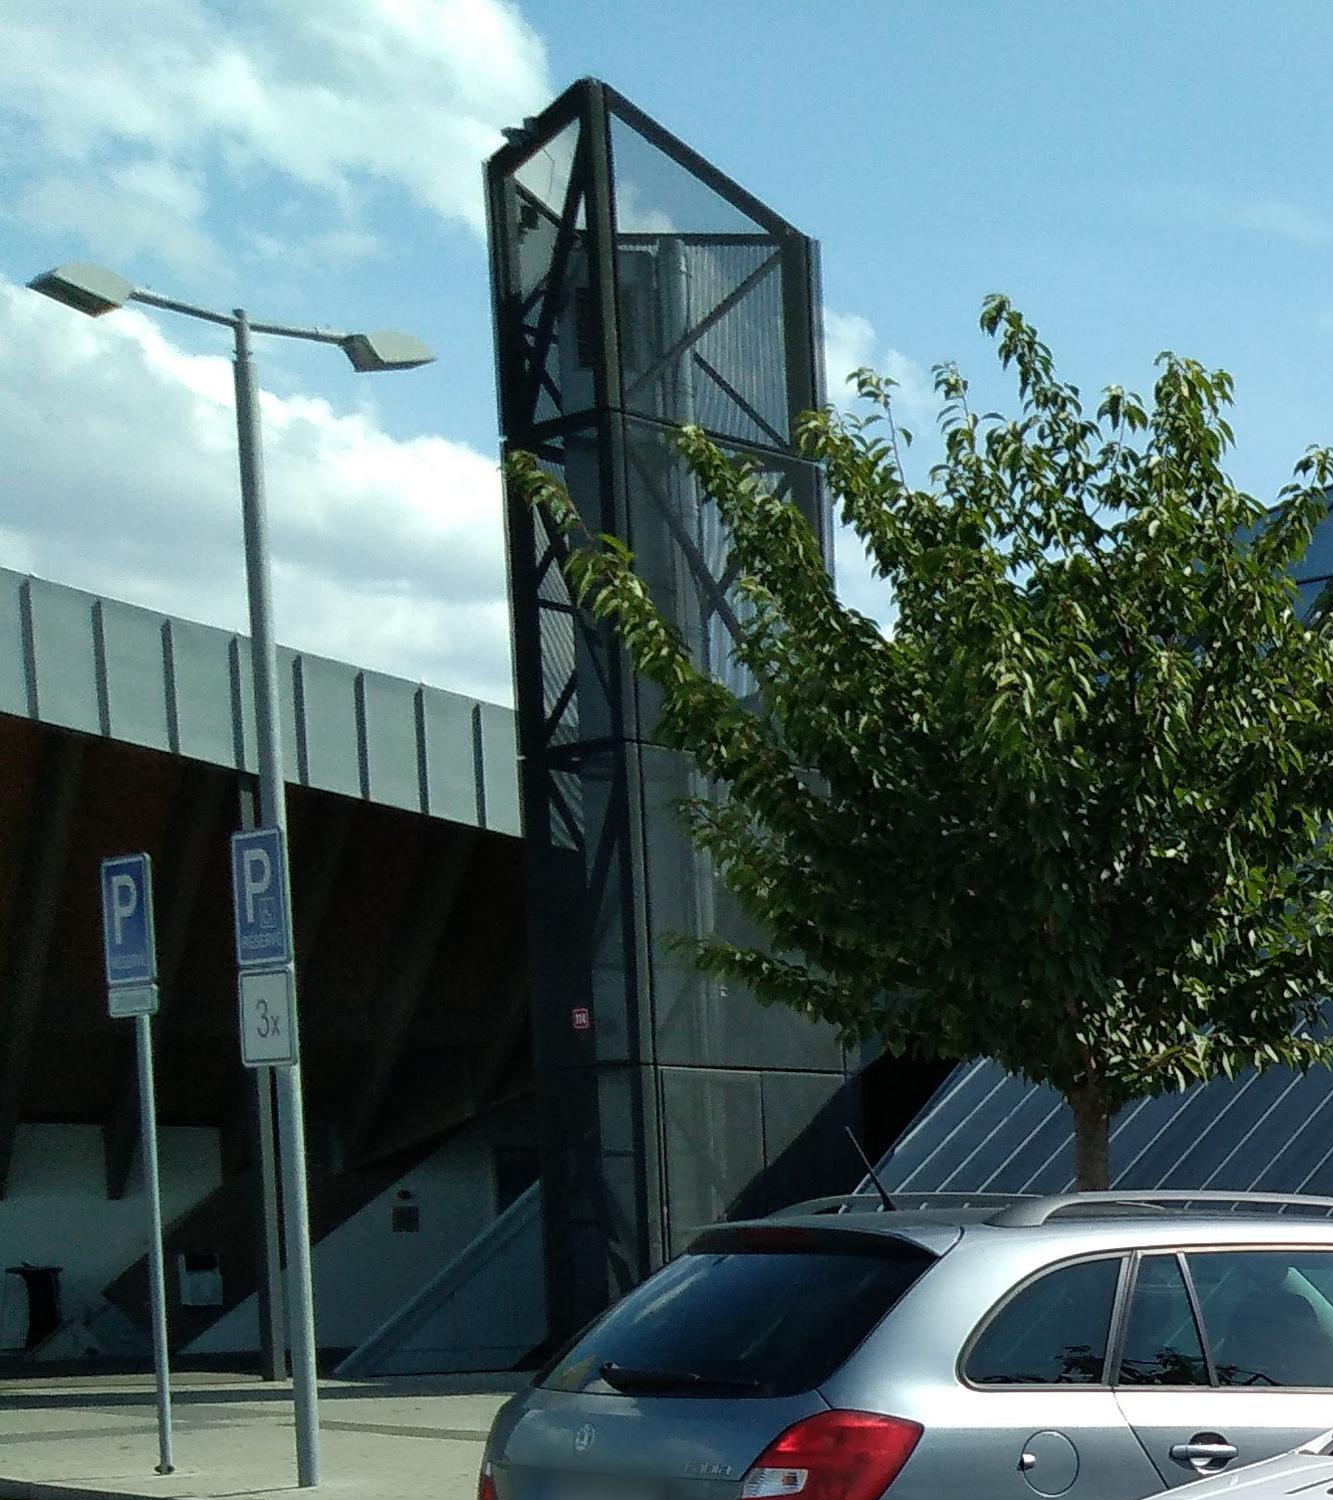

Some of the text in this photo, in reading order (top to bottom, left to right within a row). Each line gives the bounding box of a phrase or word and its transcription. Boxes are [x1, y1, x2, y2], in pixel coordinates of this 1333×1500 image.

[111, 874, 137, 944] P
[243, 849, 271, 923] P
[256, 999, 280, 1038] 3x
